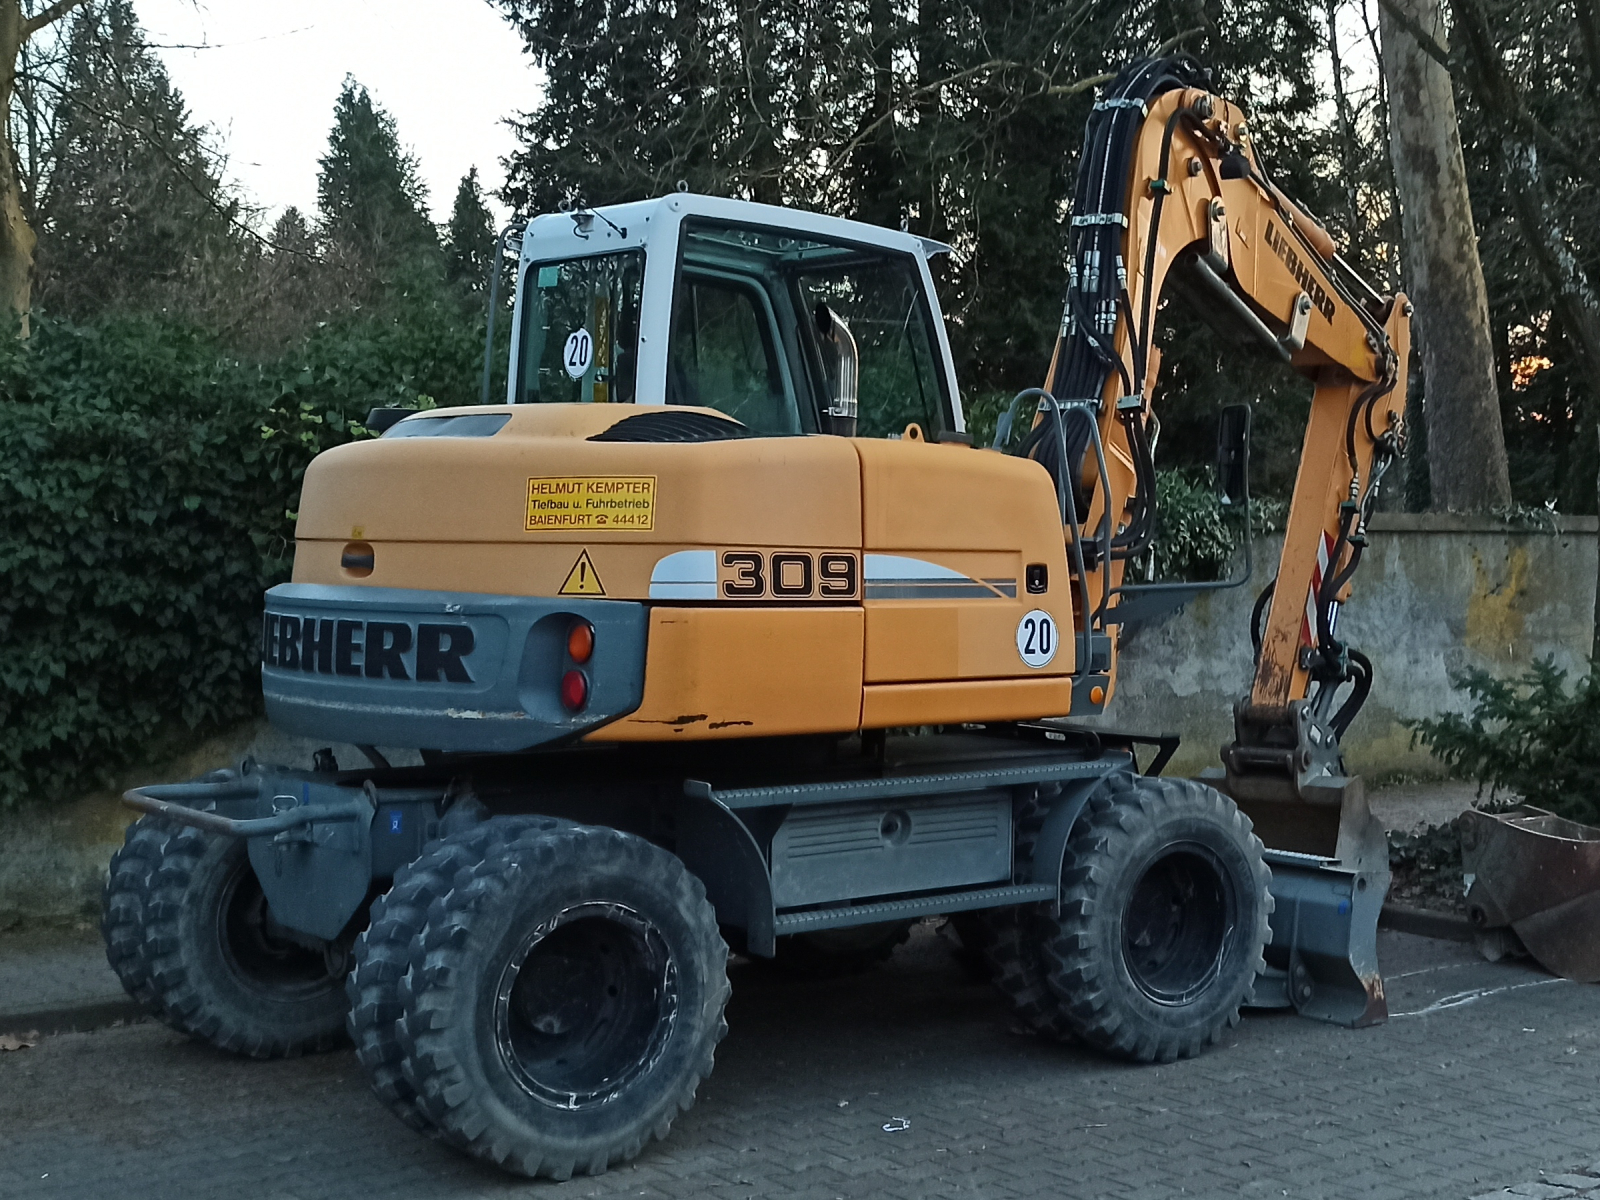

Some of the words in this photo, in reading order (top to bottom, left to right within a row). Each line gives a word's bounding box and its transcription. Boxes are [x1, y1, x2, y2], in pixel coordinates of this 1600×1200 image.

[1264, 218, 1336, 326] LIEBHERR
[568, 335, 589, 367] 20
[531, 482, 583, 494] HELMUT
[587, 482, 651, 494] KEMPTER
[531, 499, 569, 510] Tiefbau
[572, 501, 582, 509] u.
[586, 498, 650, 509] Fuhrbetrieb
[529, 514, 592, 525] BAIENFURT
[612, 514, 649, 525] 44412
[722, 551, 858, 598] 309
[1024, 618, 1051, 655] 20
